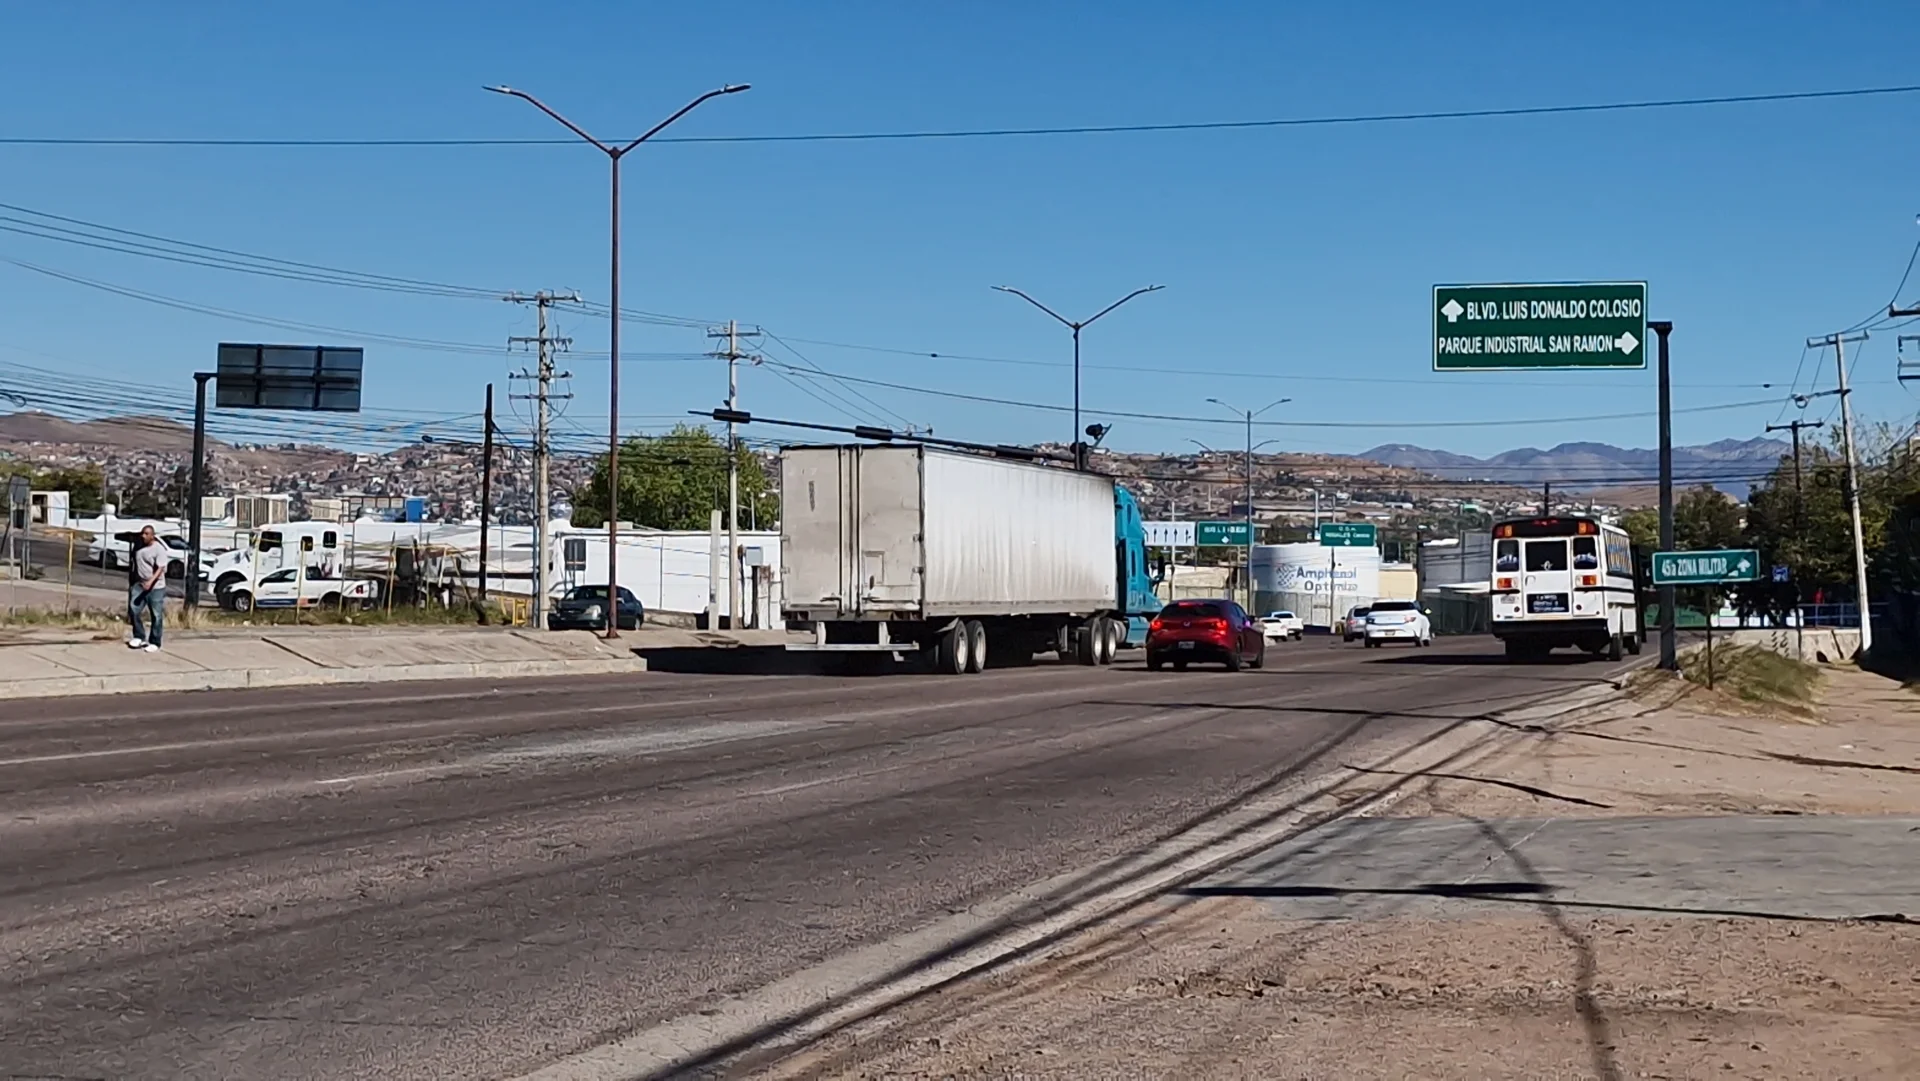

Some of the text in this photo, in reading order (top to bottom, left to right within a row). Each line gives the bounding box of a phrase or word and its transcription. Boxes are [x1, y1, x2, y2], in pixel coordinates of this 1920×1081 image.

[1467, 298, 1641, 320] BLVD. LUIS DONALDO COLOSIO
[1438, 334, 1613, 354] PARQUE INDUSTRIAL SAN RAMON
[1296, 566, 1357, 581] Amphenol
[1677, 558, 1698, 576] ZONA
[1698, 557, 1728, 575] MILITAR
[1304, 580, 1358, 595] Optmize
